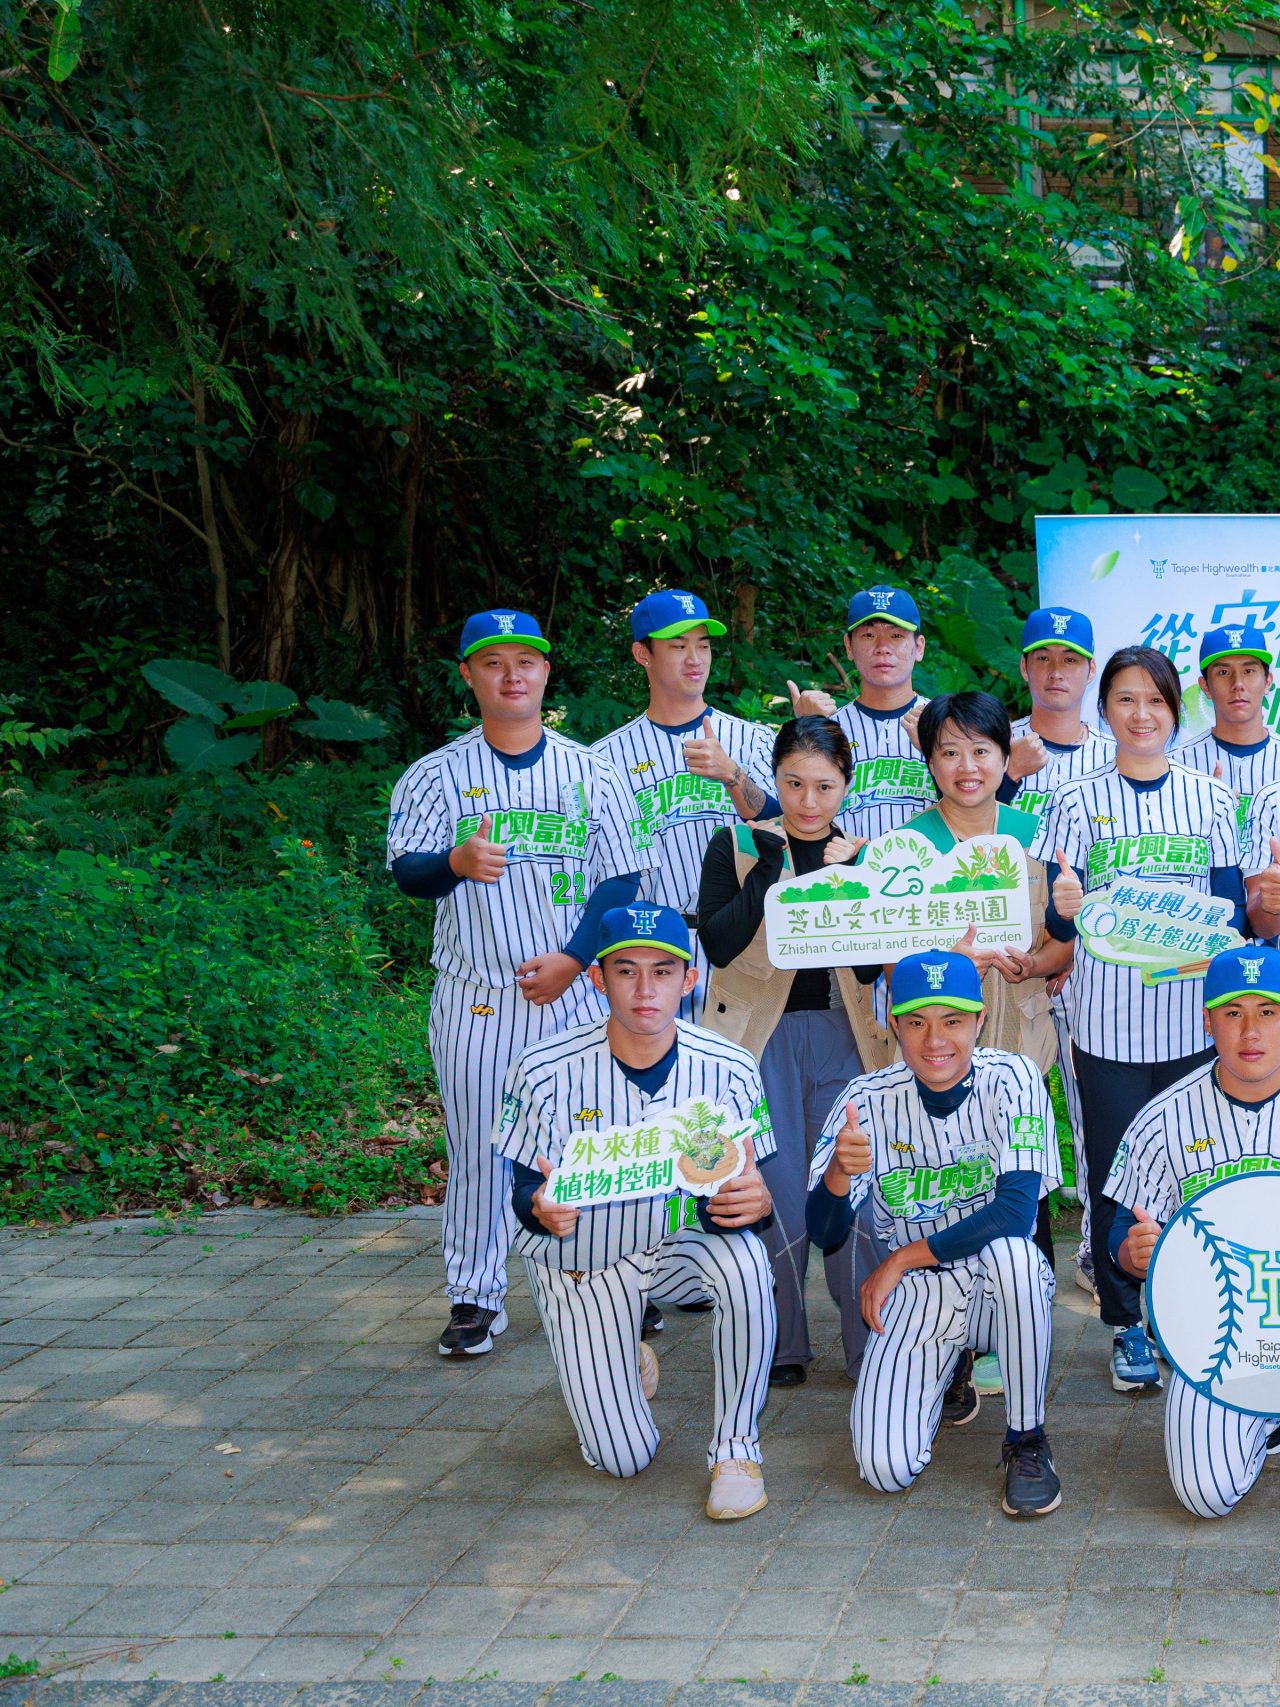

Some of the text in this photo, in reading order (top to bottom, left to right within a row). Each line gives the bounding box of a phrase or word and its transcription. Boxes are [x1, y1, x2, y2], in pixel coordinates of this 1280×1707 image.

[1171, 563, 1259, 576] Taipei Highwealth
[877, 787, 905, 797] HIGH
[515, 843, 587, 858] HIGH WEALTH
[1142, 864, 1170, 875] HIGH
[551, 871, 588, 906] 22
[787, 895, 1009, 935] 芝山文化生態綠園
[1111, 885, 1227, 928] 棒球興力量
[778, 931, 1022, 957] Zhishan Cultural and Ecologic Garden
[570, 1125, 662, 1167] 外來種
[553, 1156, 673, 1205] 植物控制
